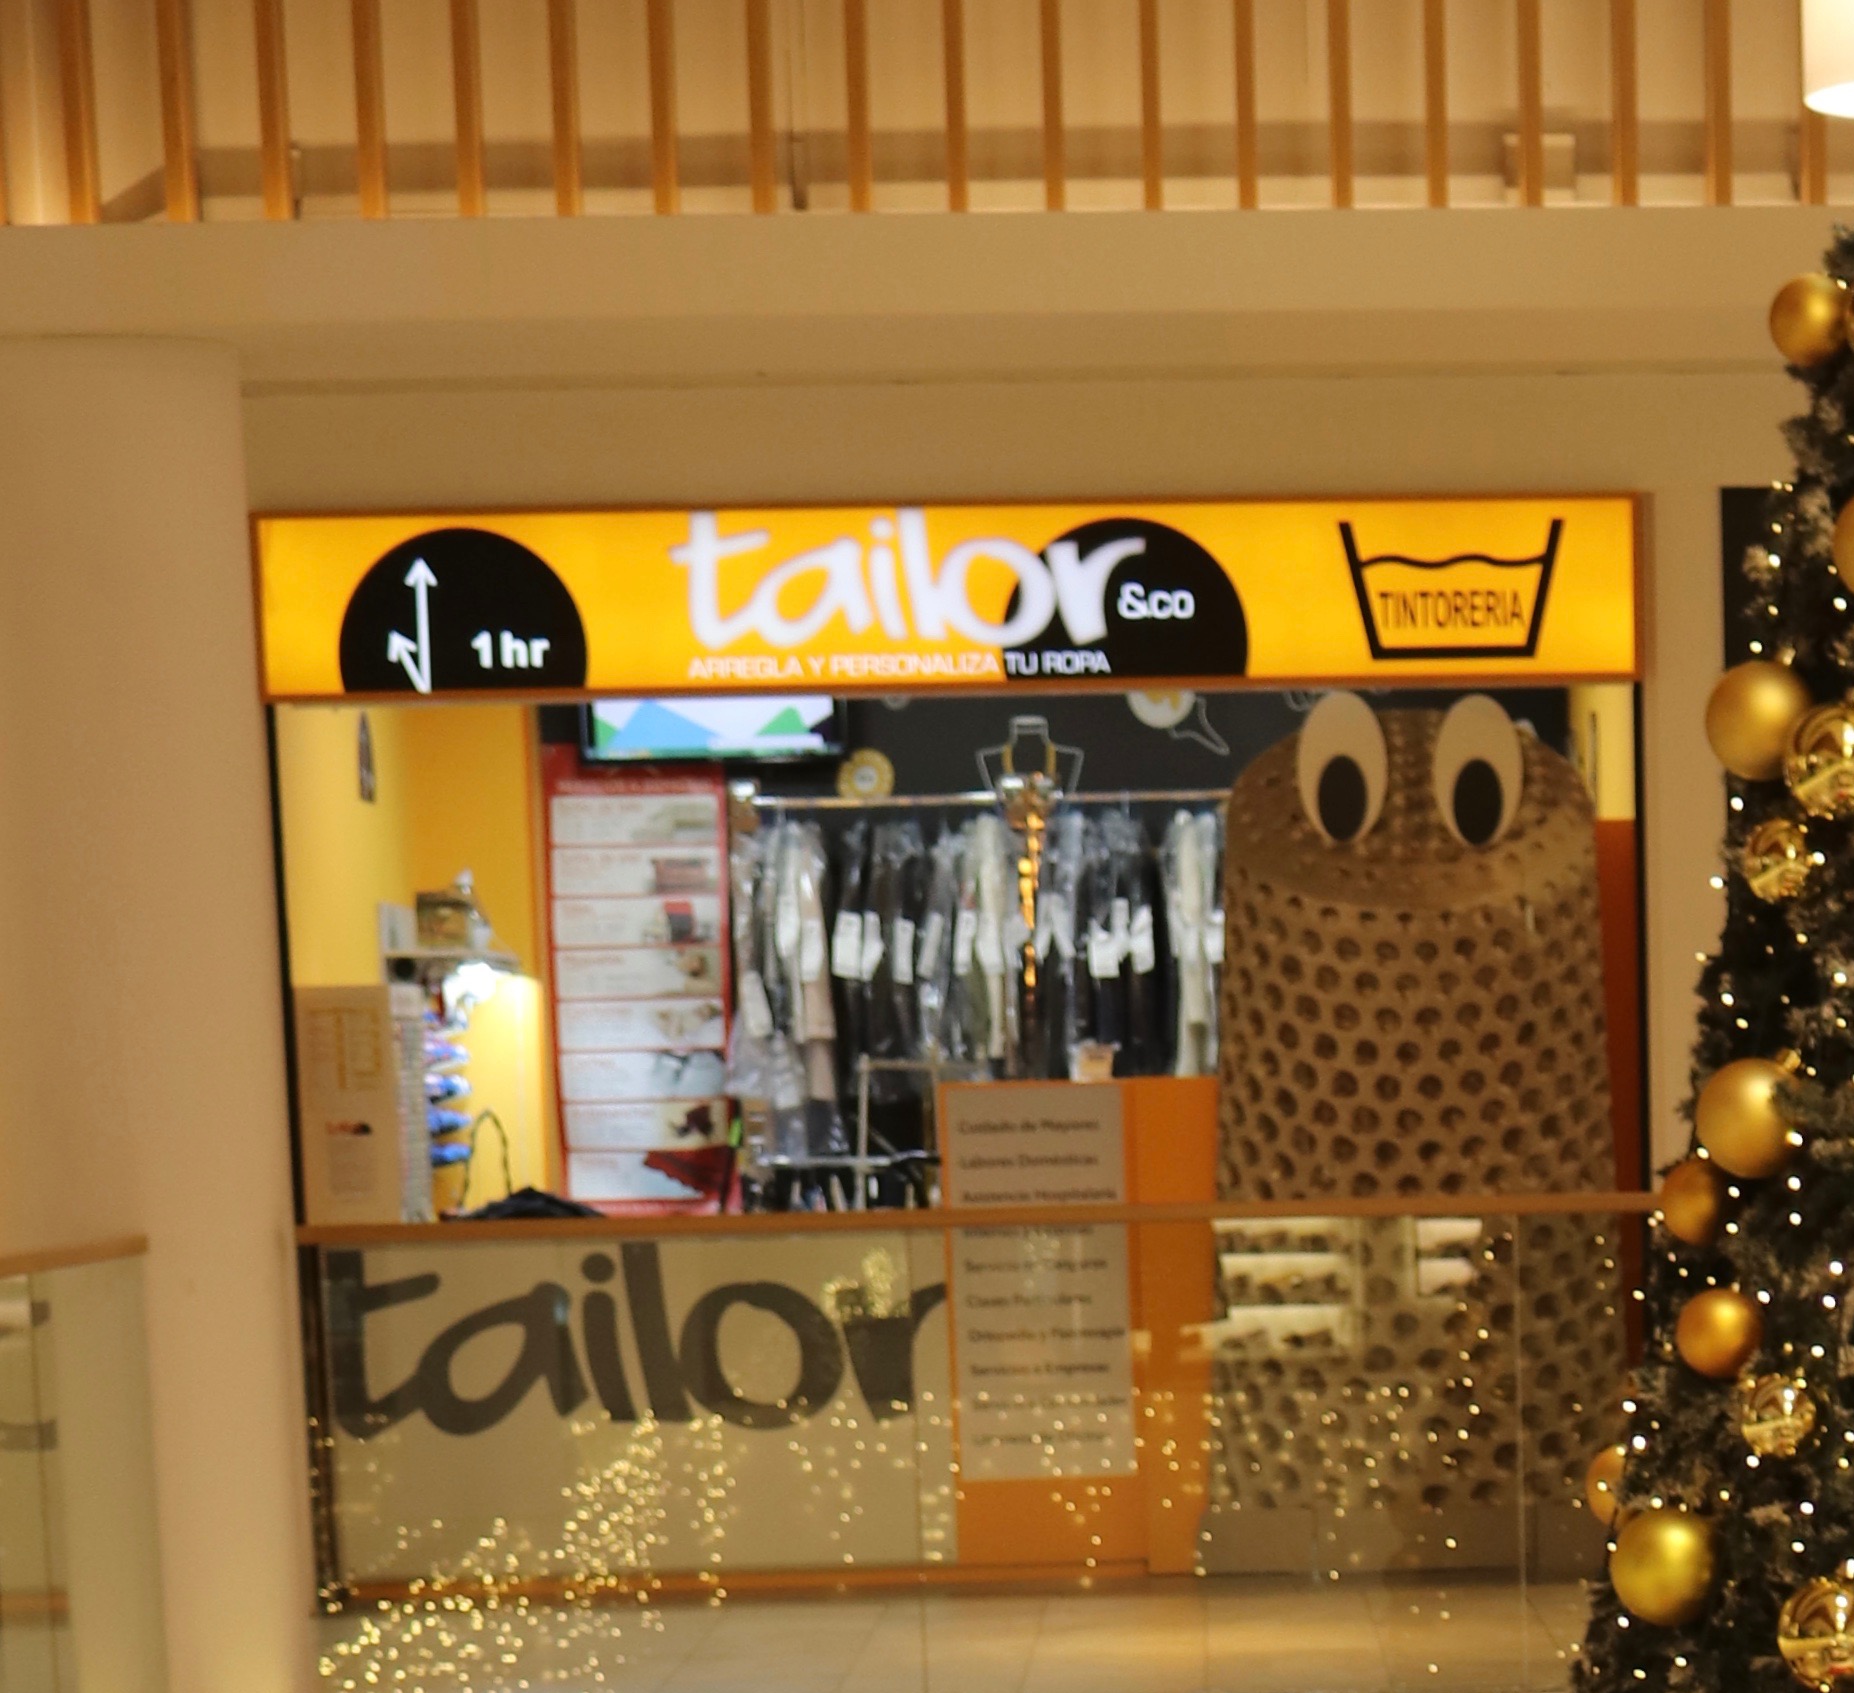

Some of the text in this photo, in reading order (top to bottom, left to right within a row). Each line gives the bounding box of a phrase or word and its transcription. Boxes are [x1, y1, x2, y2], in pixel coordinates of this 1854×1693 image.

[669, 507, 1196, 649] tailor &co
[1380, 590, 1526, 628] TINTORERIA
[470, 629, 551, 670] 1 hr
[688, 649, 1112, 679] ARREGLA Y PERSONALIZA TU ROPA
[325, 1241, 947, 1437] tailor
